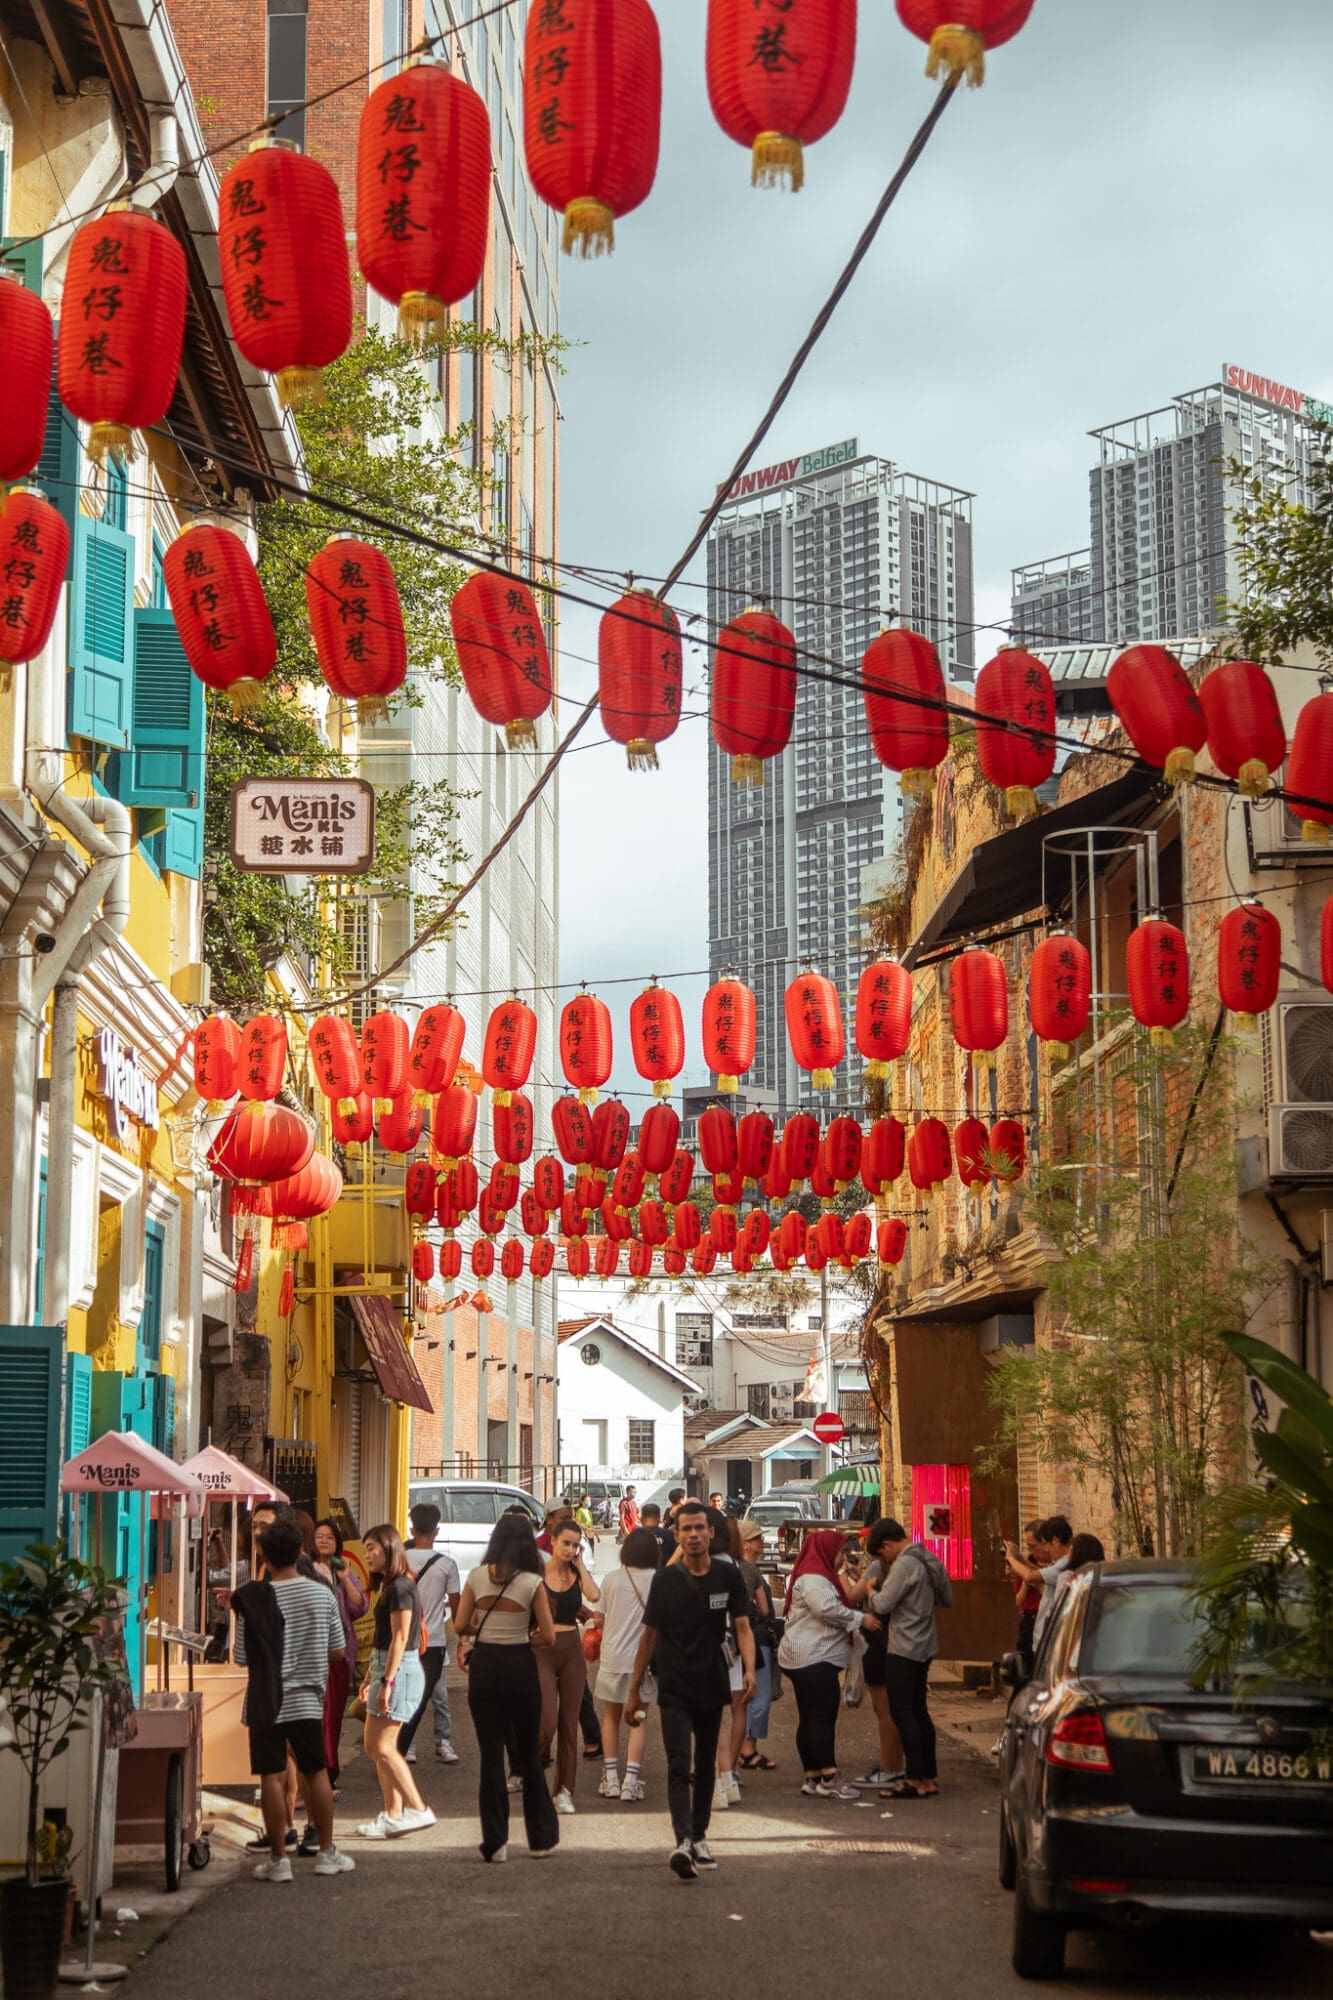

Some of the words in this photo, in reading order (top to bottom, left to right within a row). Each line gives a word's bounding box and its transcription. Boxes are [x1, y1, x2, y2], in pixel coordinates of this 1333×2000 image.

[377, 94, 428, 241] 鬼仔巷
[228, 179, 284, 323] 鬼仔巷
[80, 236, 129, 375] 鬼仔巷
[1228, 366, 1304, 412] SUNWAY
[802, 437, 858, 475] Belfield
[0, 519, 43, 629] 鬼仔巷
[182, 550, 236, 652] 鬼仔巷
[336, 559, 380, 663] 鬼仔巷
[251, 793, 356, 833] Manis
[318, 820, 344, 833] KL
[261, 836, 343, 856] 糖水铺
[493, 1014, 516, 1073] 鬼仔巷
[80, 1463, 140, 1486] Manis
[1209, 1752, 1237, 1775] WA
[1245, 1754, 1309, 1778] 4866
[1317, 1760, 1331, 1779] W
